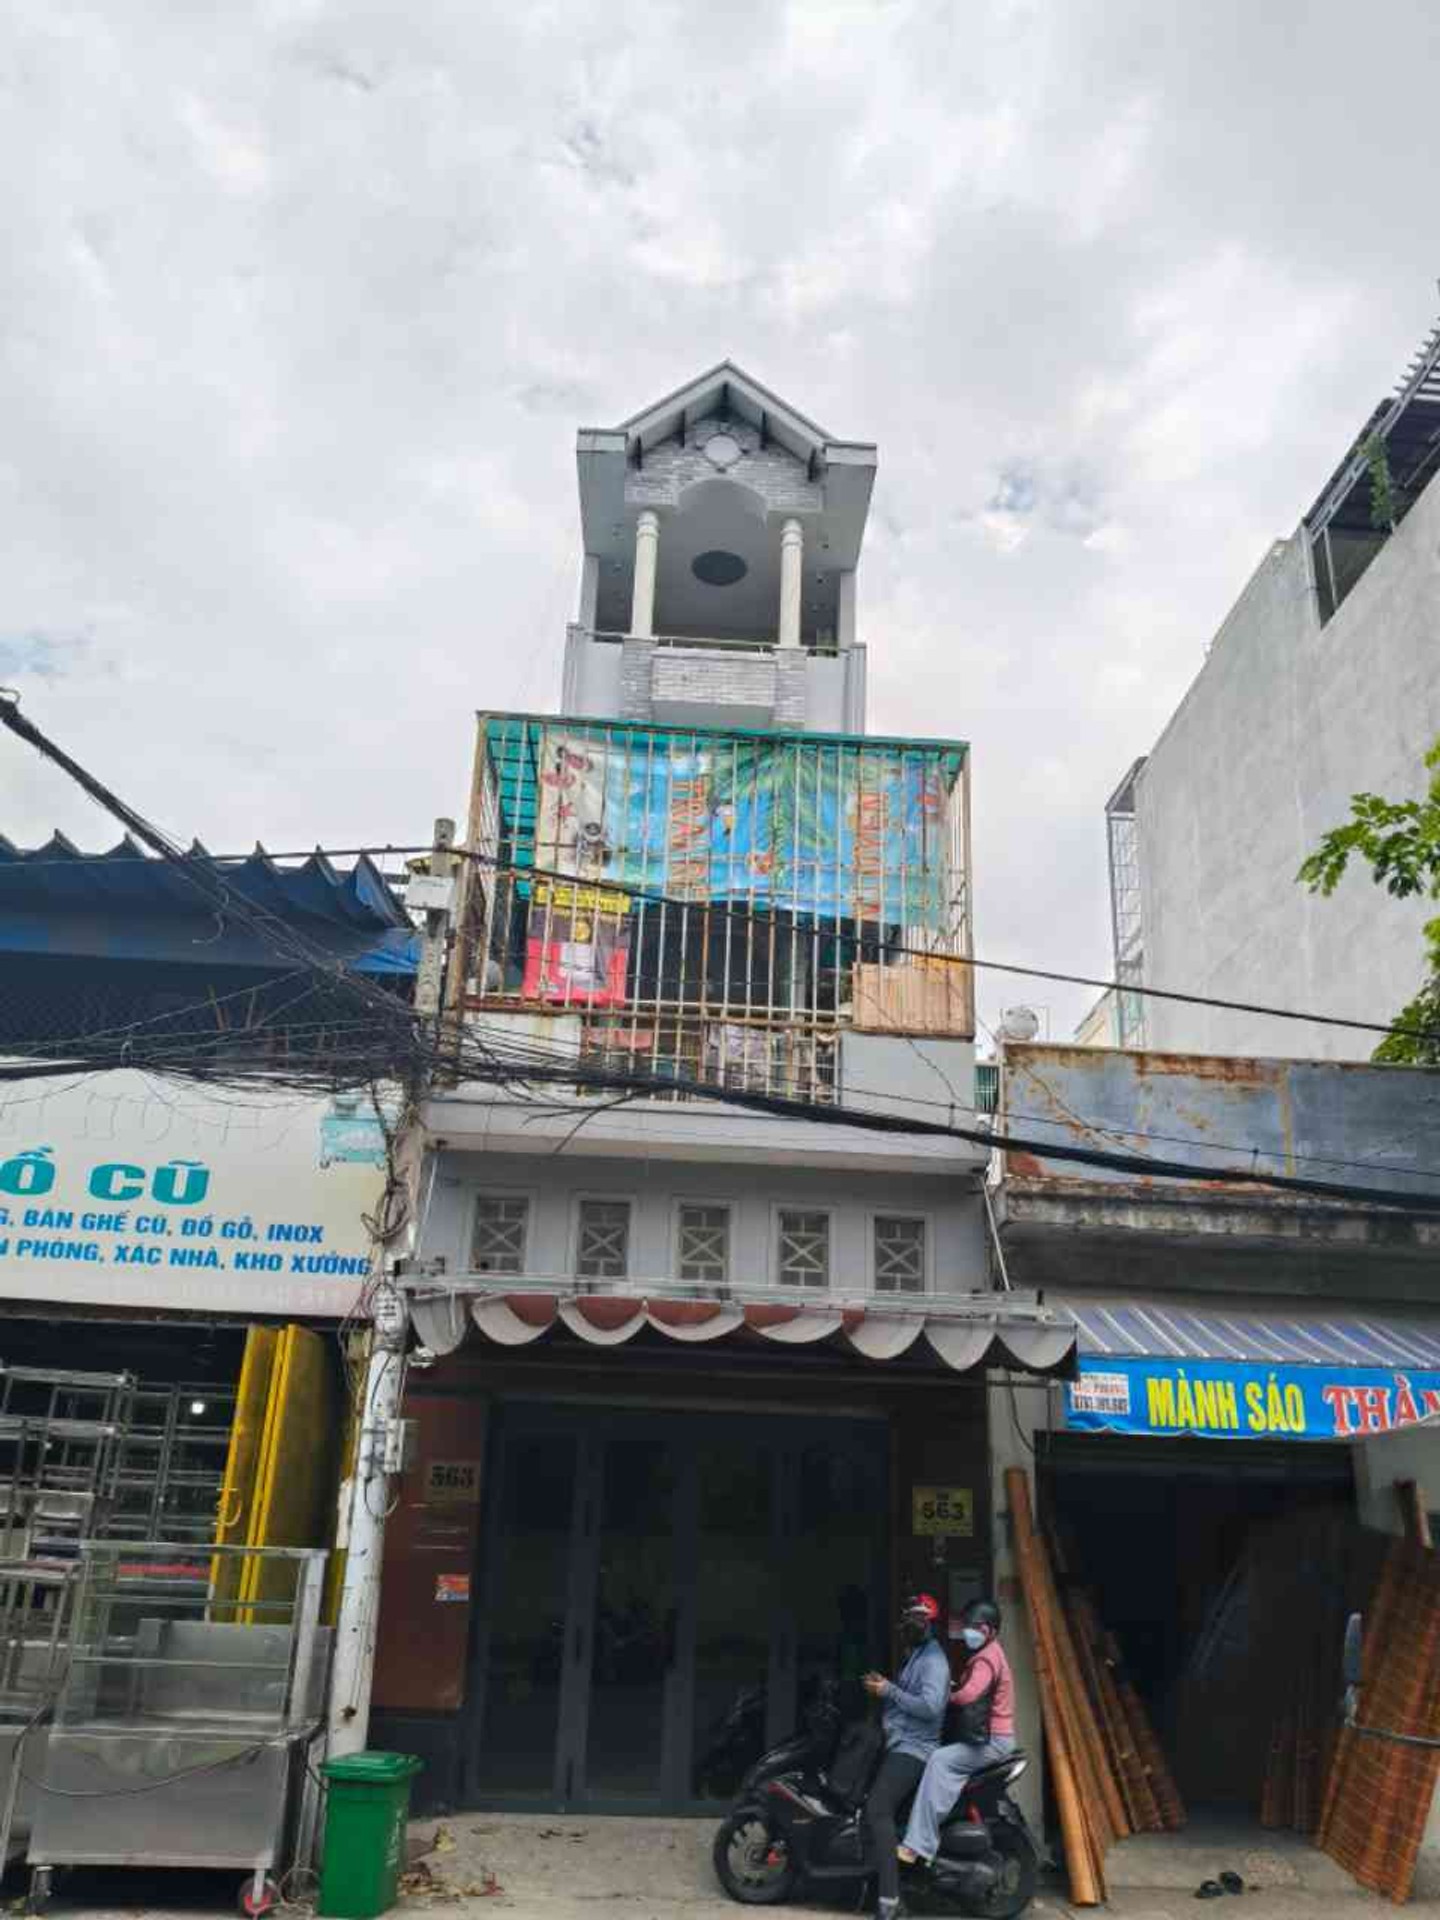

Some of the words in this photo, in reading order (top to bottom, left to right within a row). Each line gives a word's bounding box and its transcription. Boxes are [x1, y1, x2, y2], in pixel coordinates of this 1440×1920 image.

[89, 1160, 210, 1206] CŨ
[81, 1210, 130, 1233] GHẾ
[268, 1224, 324, 1243] INOX
[234, 1251, 283, 1272] KHO
[290, 1250, 373, 1277] XƯỞNG
[1147, 1368, 1239, 1430] MÀNH
[1244, 1372, 1306, 1433] SÁO
[922, 1501, 965, 1521] 563
